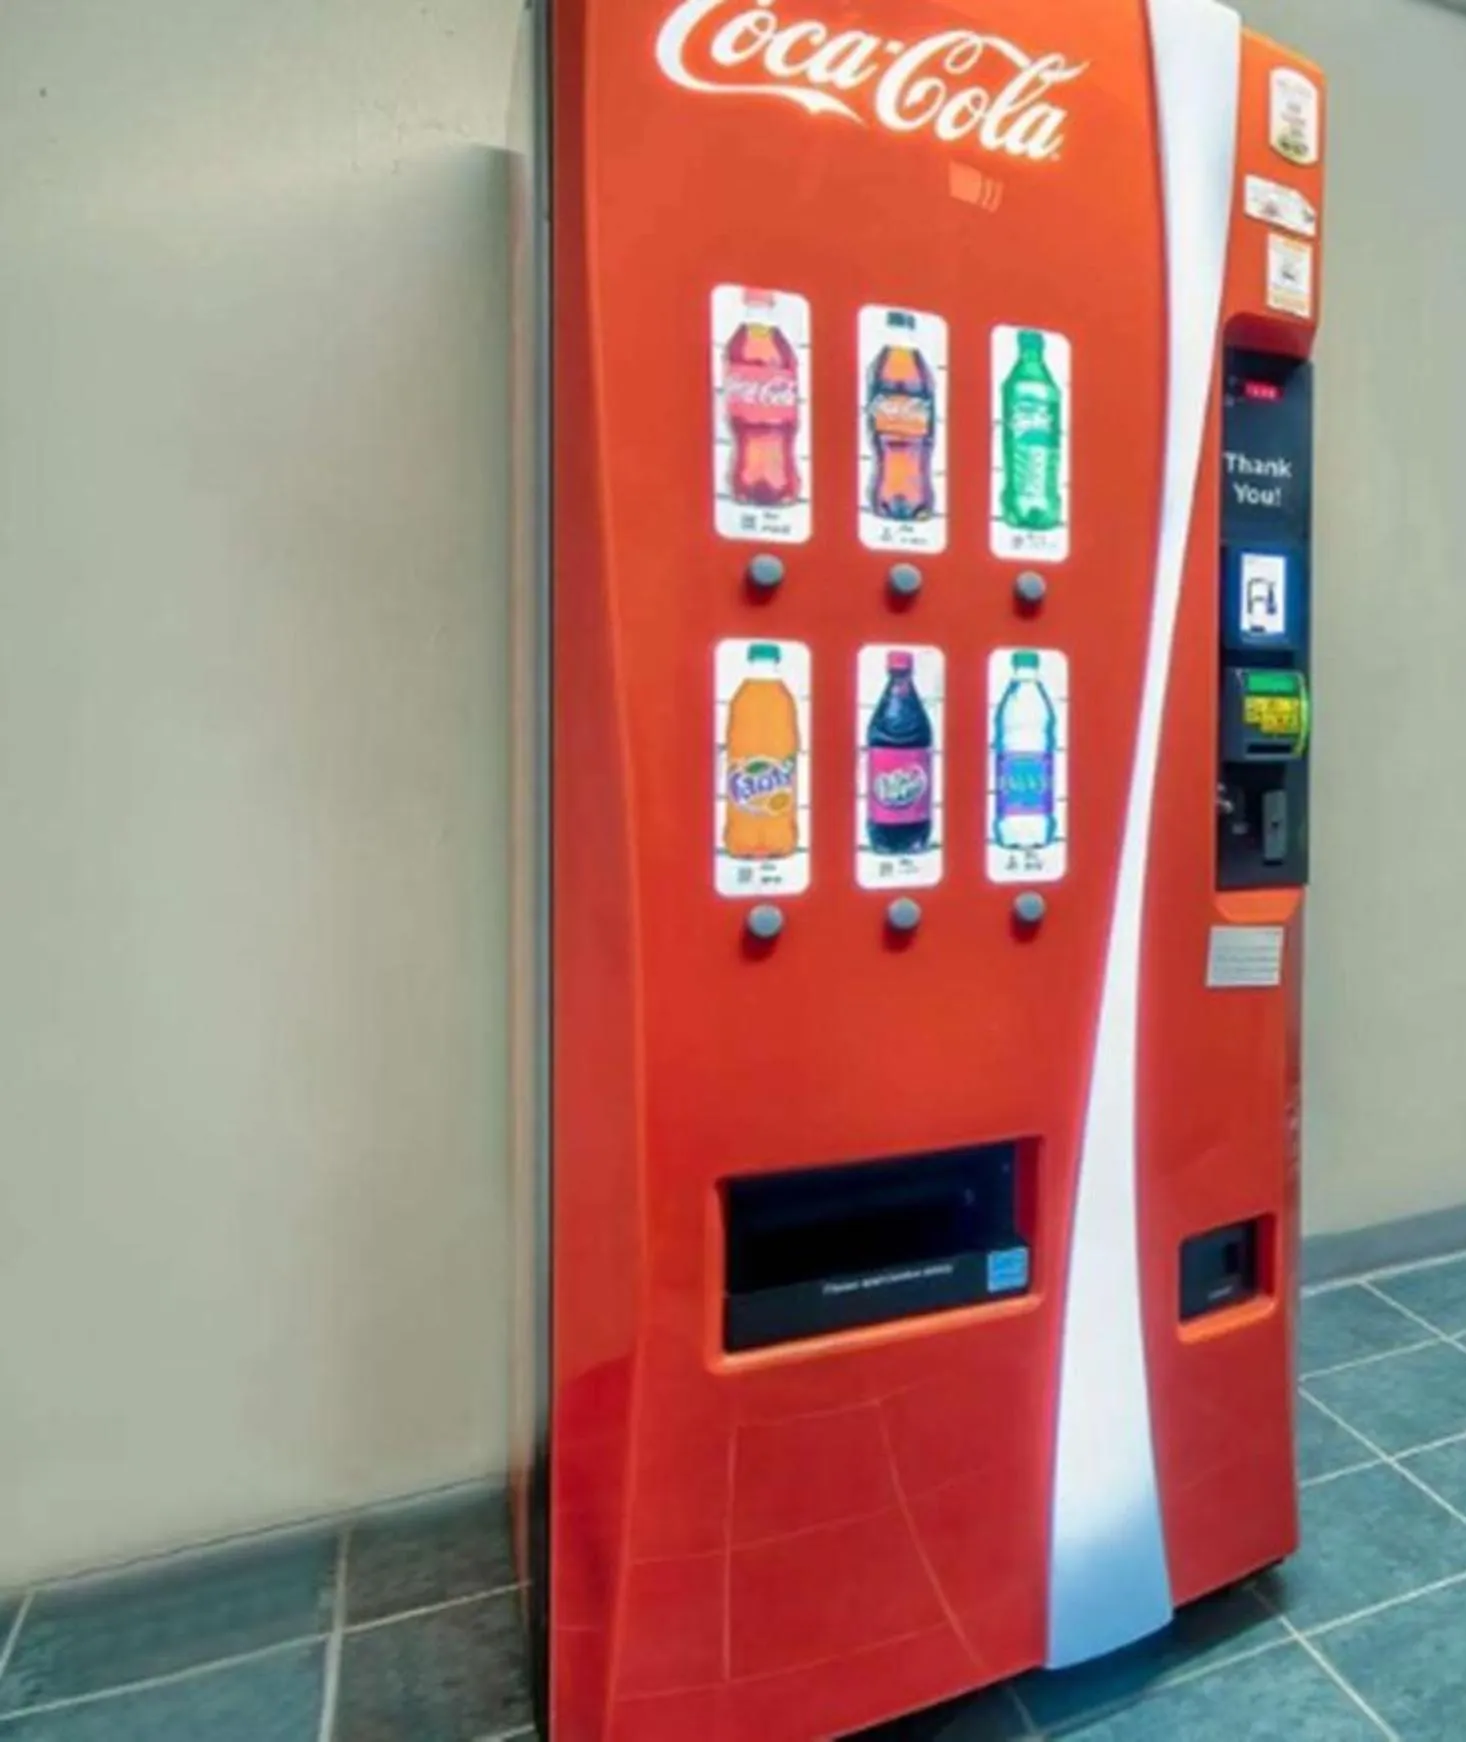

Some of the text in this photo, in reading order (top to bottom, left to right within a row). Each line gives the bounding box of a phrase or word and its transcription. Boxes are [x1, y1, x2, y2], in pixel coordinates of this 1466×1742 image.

[655, 0, 1091, 161] Coca-Cola
[1223, 452, 1292, 478] Thank
[1233, 481, 1282, 506] You!
